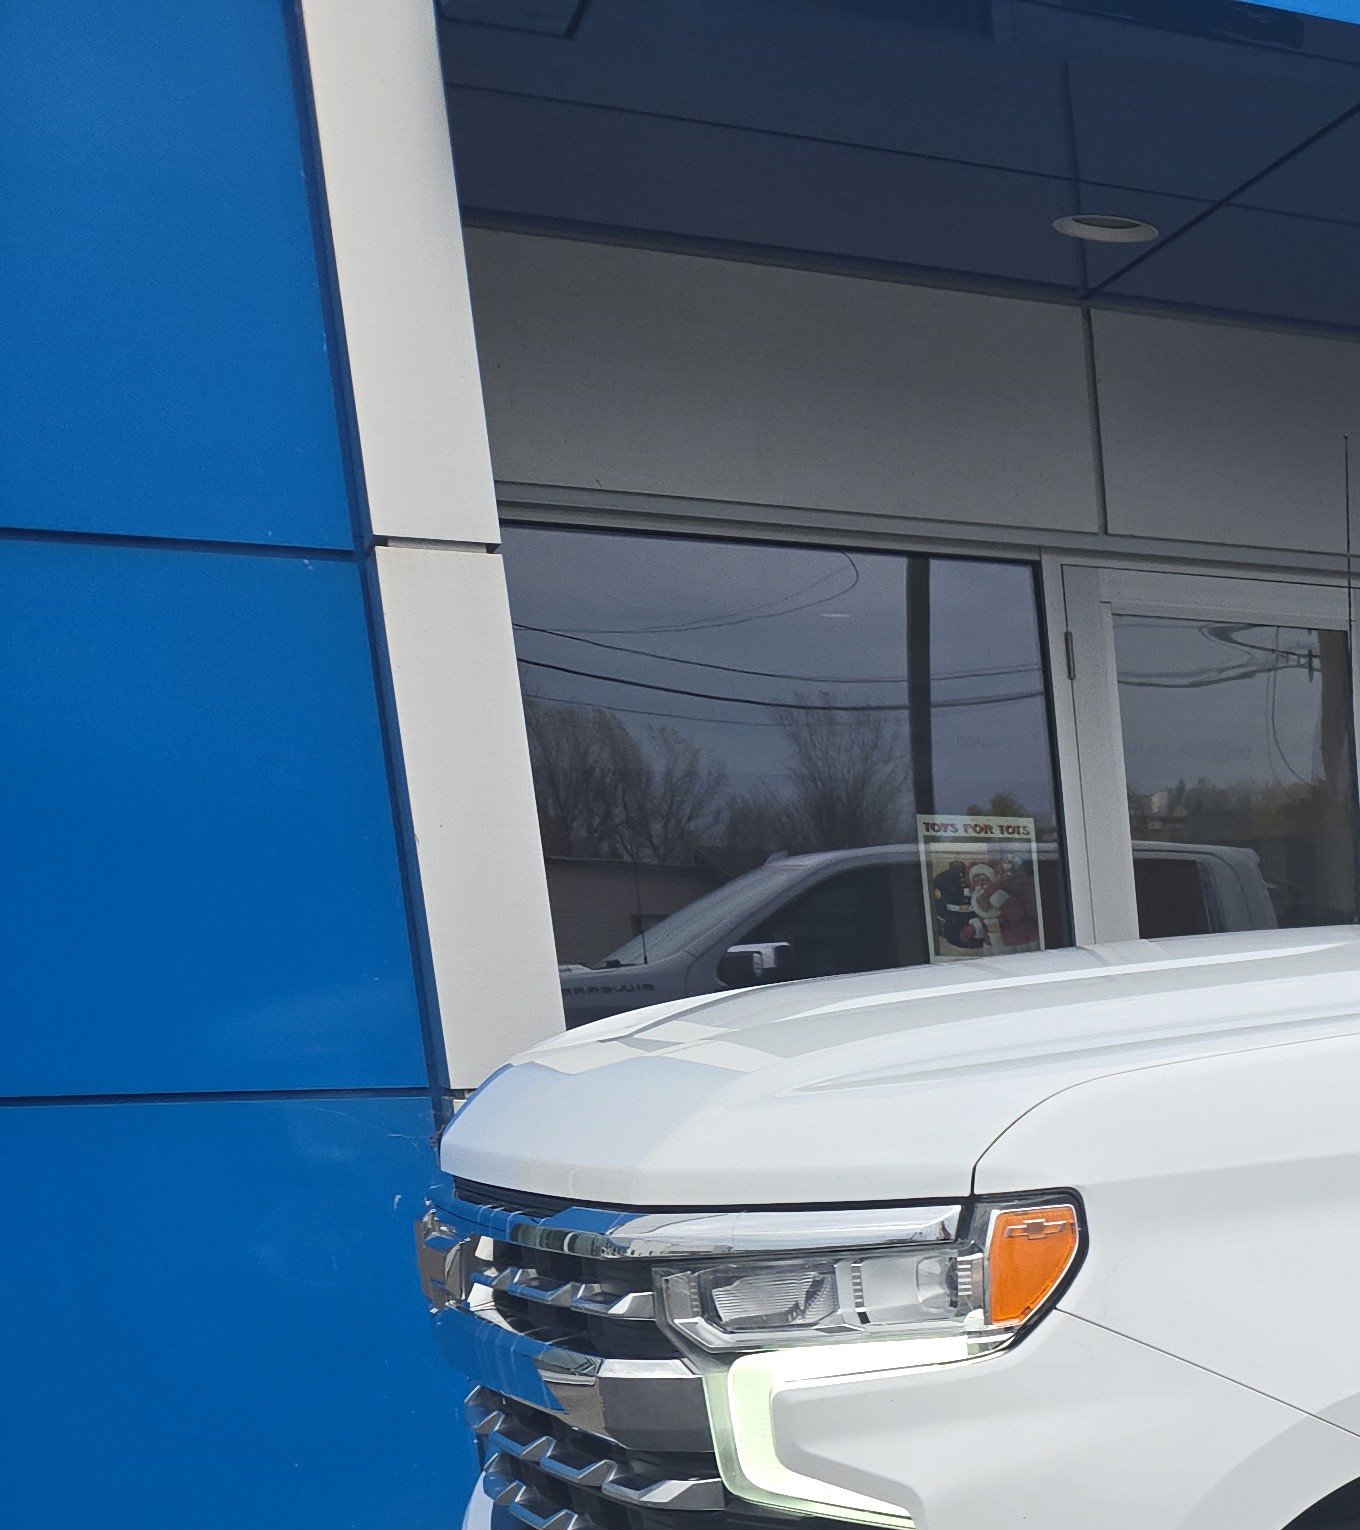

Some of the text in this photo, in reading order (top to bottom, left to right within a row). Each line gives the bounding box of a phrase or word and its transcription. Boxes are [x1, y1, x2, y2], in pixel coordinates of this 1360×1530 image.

[923, 821, 1031, 836] TOYS FOR TOTS
